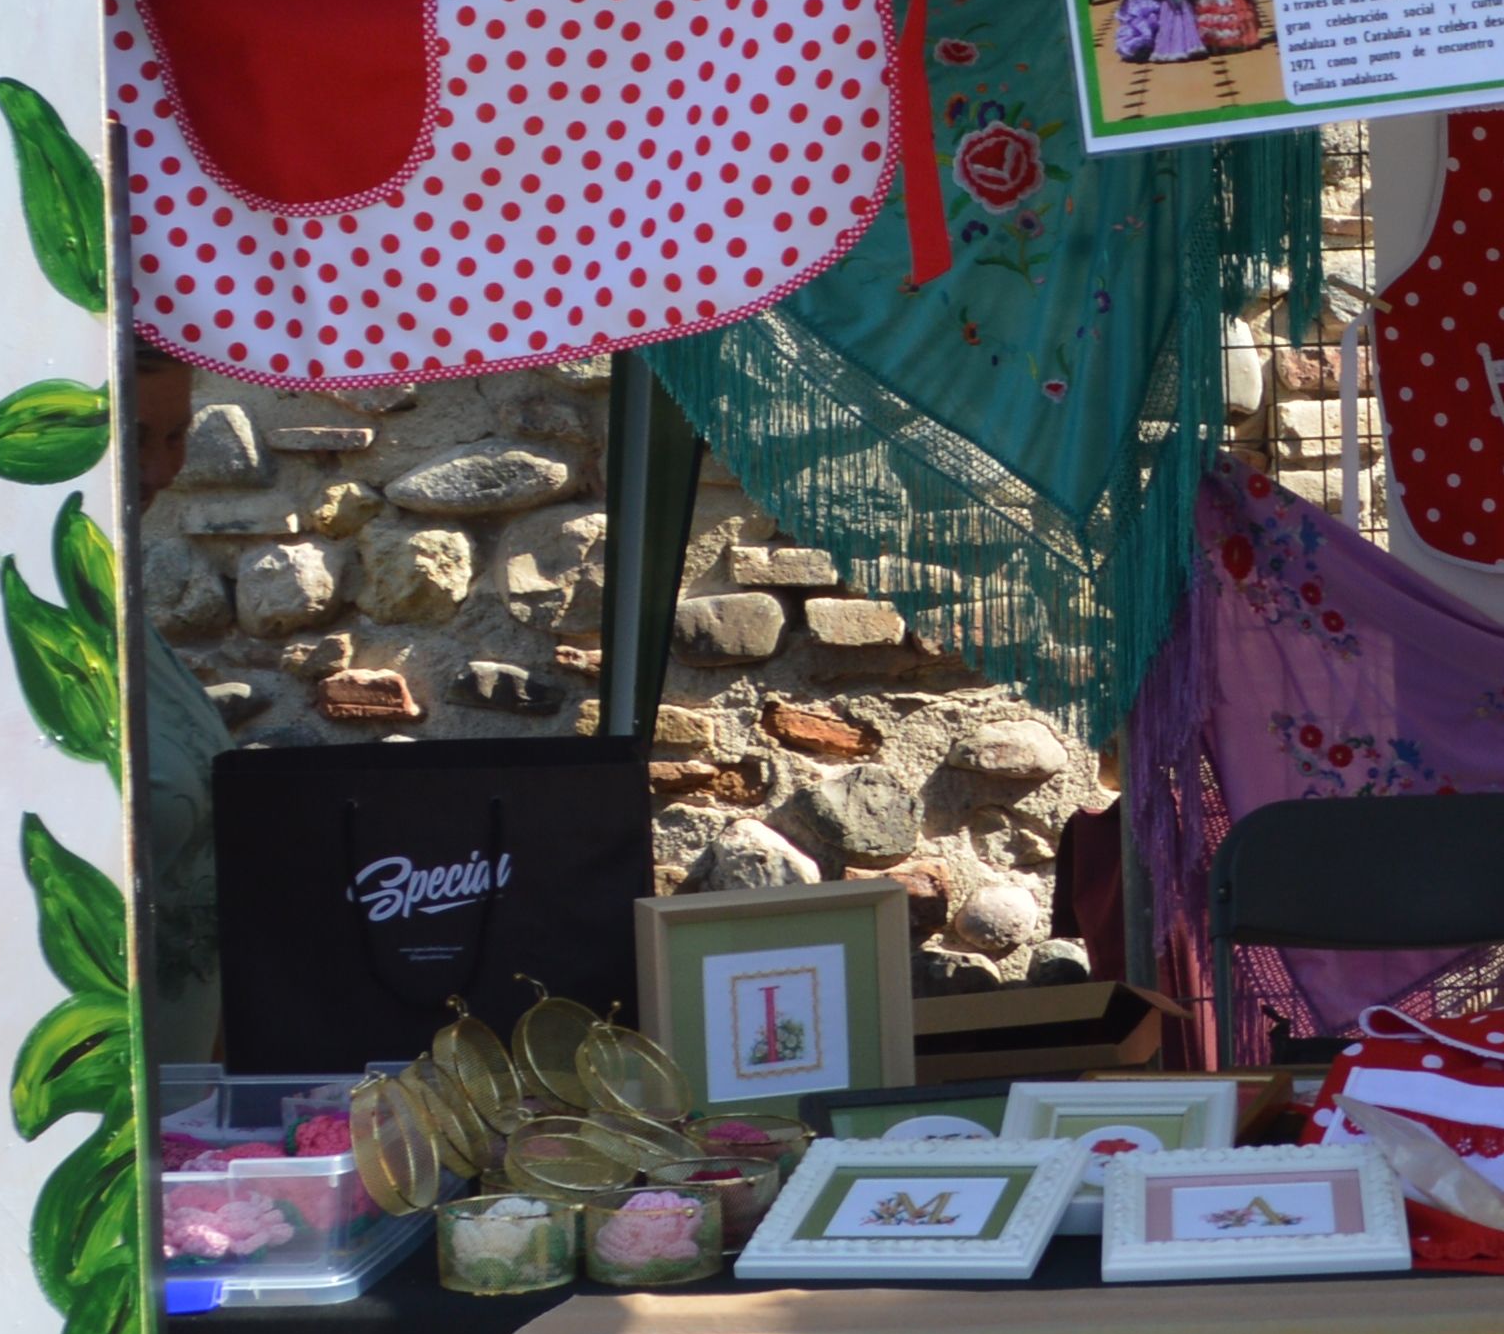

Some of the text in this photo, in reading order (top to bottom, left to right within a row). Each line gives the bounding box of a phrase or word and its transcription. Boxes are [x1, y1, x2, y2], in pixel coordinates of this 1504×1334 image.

[1283, 2, 1290, 12] a
[1285, 20, 1311, 35] gran
[1326, 9, 1389, 28] celebración
[1403, 2, 1435, 18] social
[1449, 2, 1457, 15] y
[1288, 37, 1336, 53] andaluza
[1343, 34, 1358, 45] en
[1364, 26, 1412, 43] Cataluña
[1419, 26, 1431, 36] se
[1438, 18, 1477, 34] celebra
[1291, 58, 1316, 72] 1971
[1327, 55, 1358, 68] como
[1369, 50, 1401, 65] punto
[1412, 45, 1426, 57] de
[1437, 37, 1494, 55] encuentro
[1293, 71, 1398, 95] familias andaluzas.
[347, 850, 511, 921] Special
